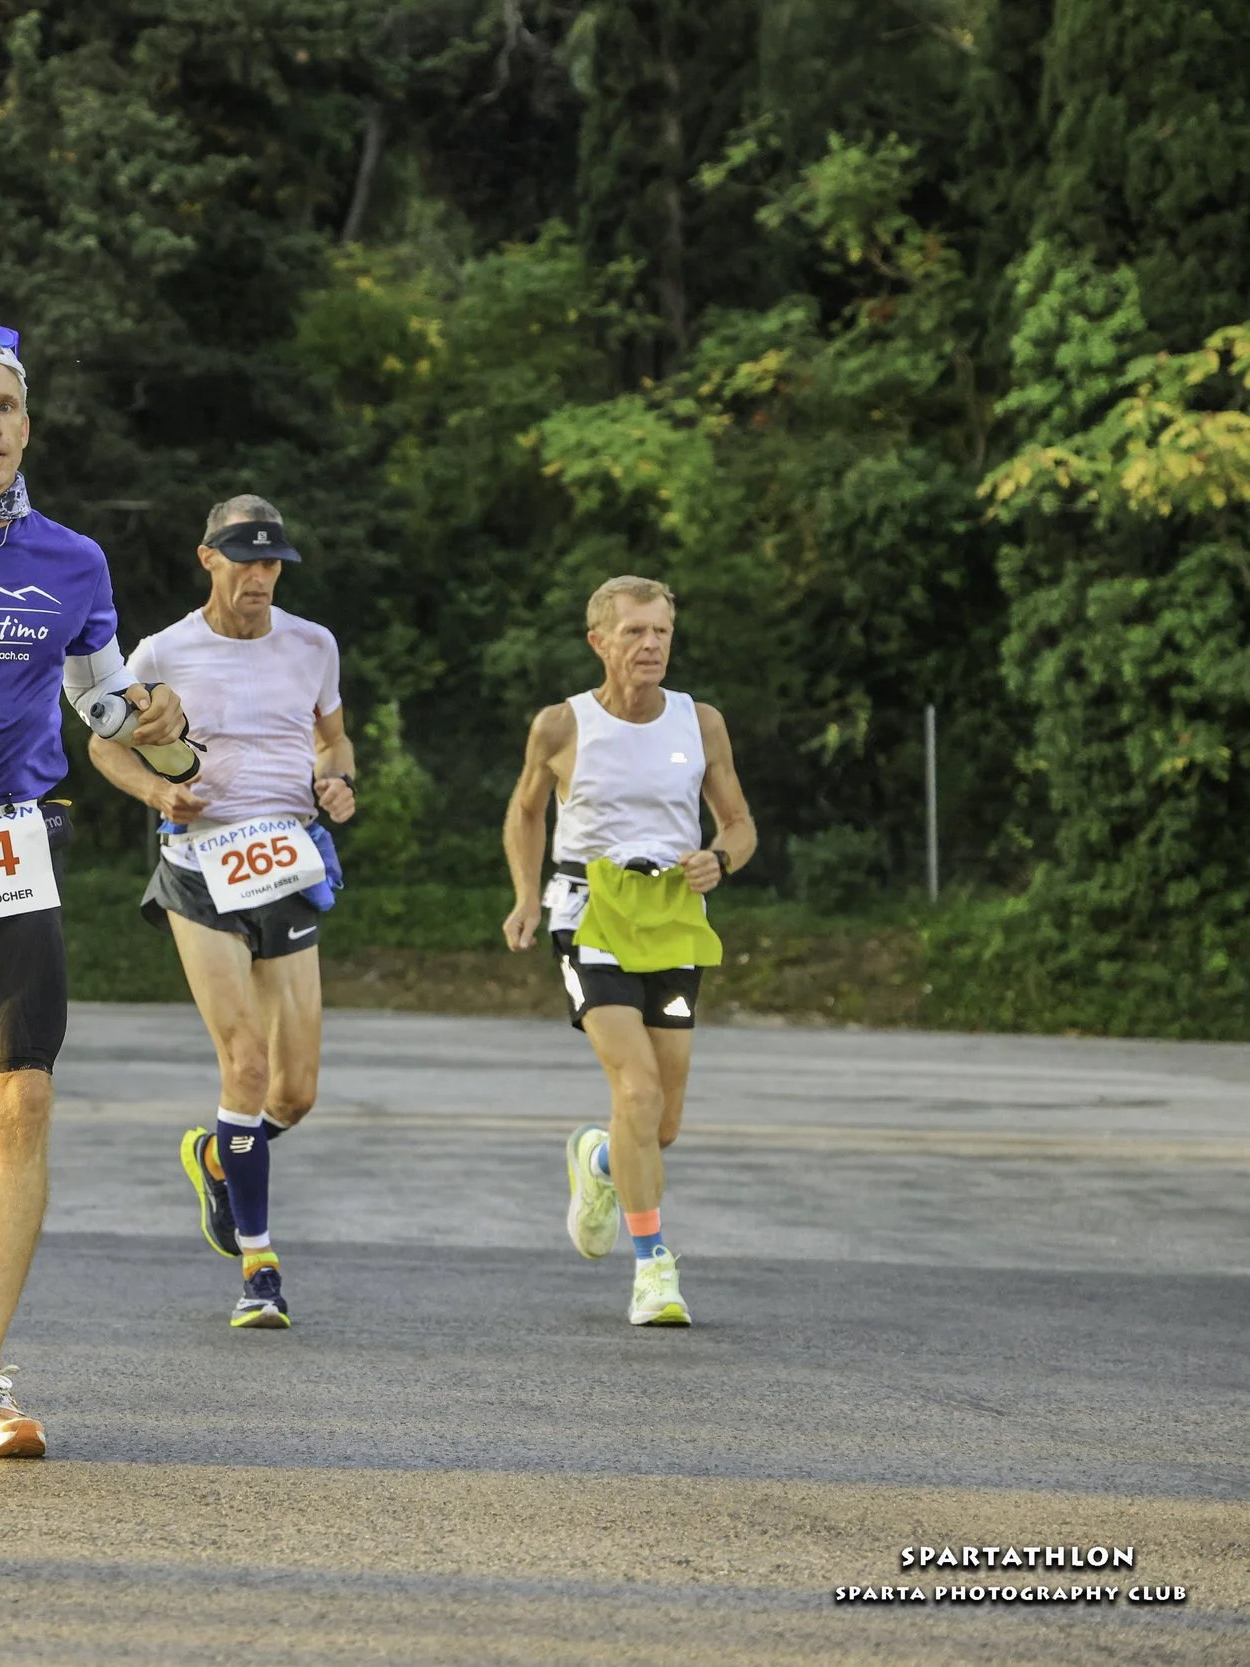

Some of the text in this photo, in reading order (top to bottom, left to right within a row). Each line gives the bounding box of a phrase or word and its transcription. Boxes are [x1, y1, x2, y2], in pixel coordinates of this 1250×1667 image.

[221, 835, 298, 886] 265
[240, 874, 299, 899] LOTHAR ESSER
